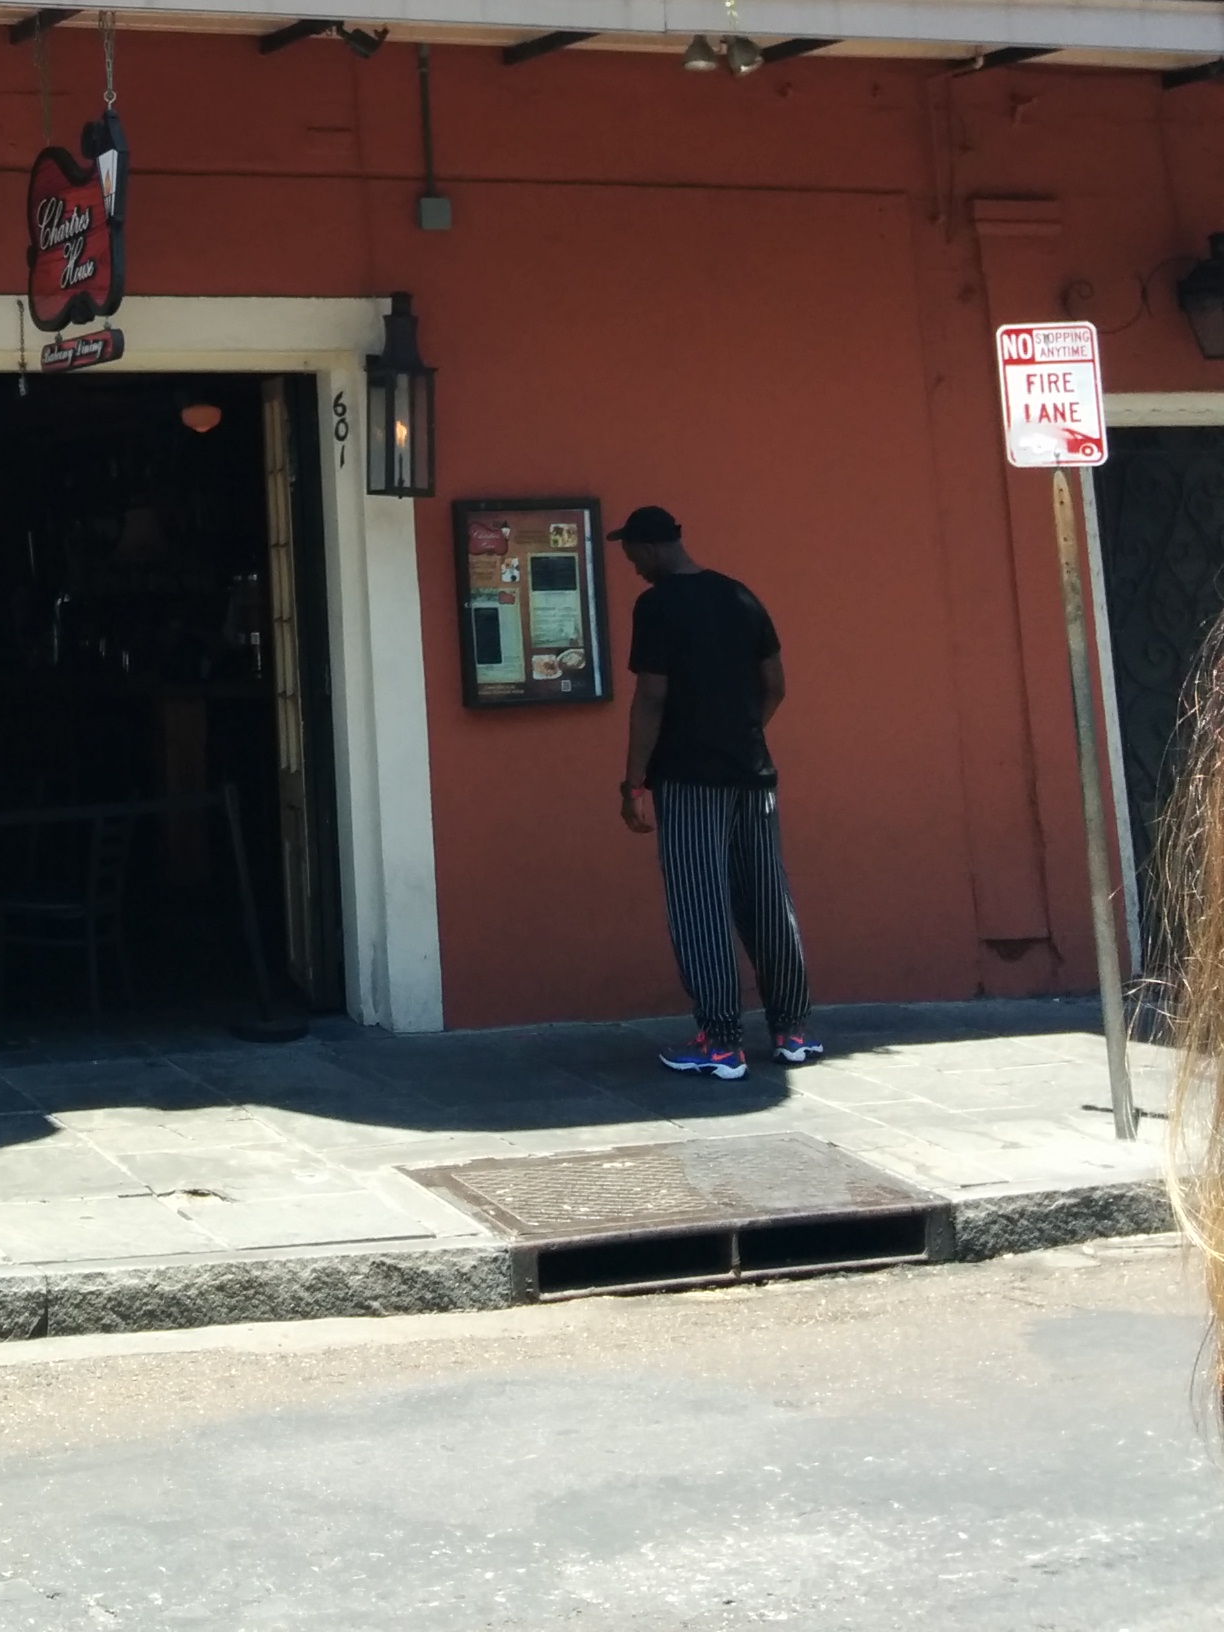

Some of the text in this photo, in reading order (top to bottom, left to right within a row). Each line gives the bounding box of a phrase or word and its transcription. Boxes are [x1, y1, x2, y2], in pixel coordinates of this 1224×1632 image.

[37, 197, 91, 251] Chartres
[61, 239, 94, 289] House
[1002, 331, 1090, 360] NO STOPPING
[1040, 346, 1088, 358] ANYTIME
[1026, 372, 1075, 395] FIRE
[1024, 402, 1082, 424] LANE
[333, 391, 349, 469] 601
